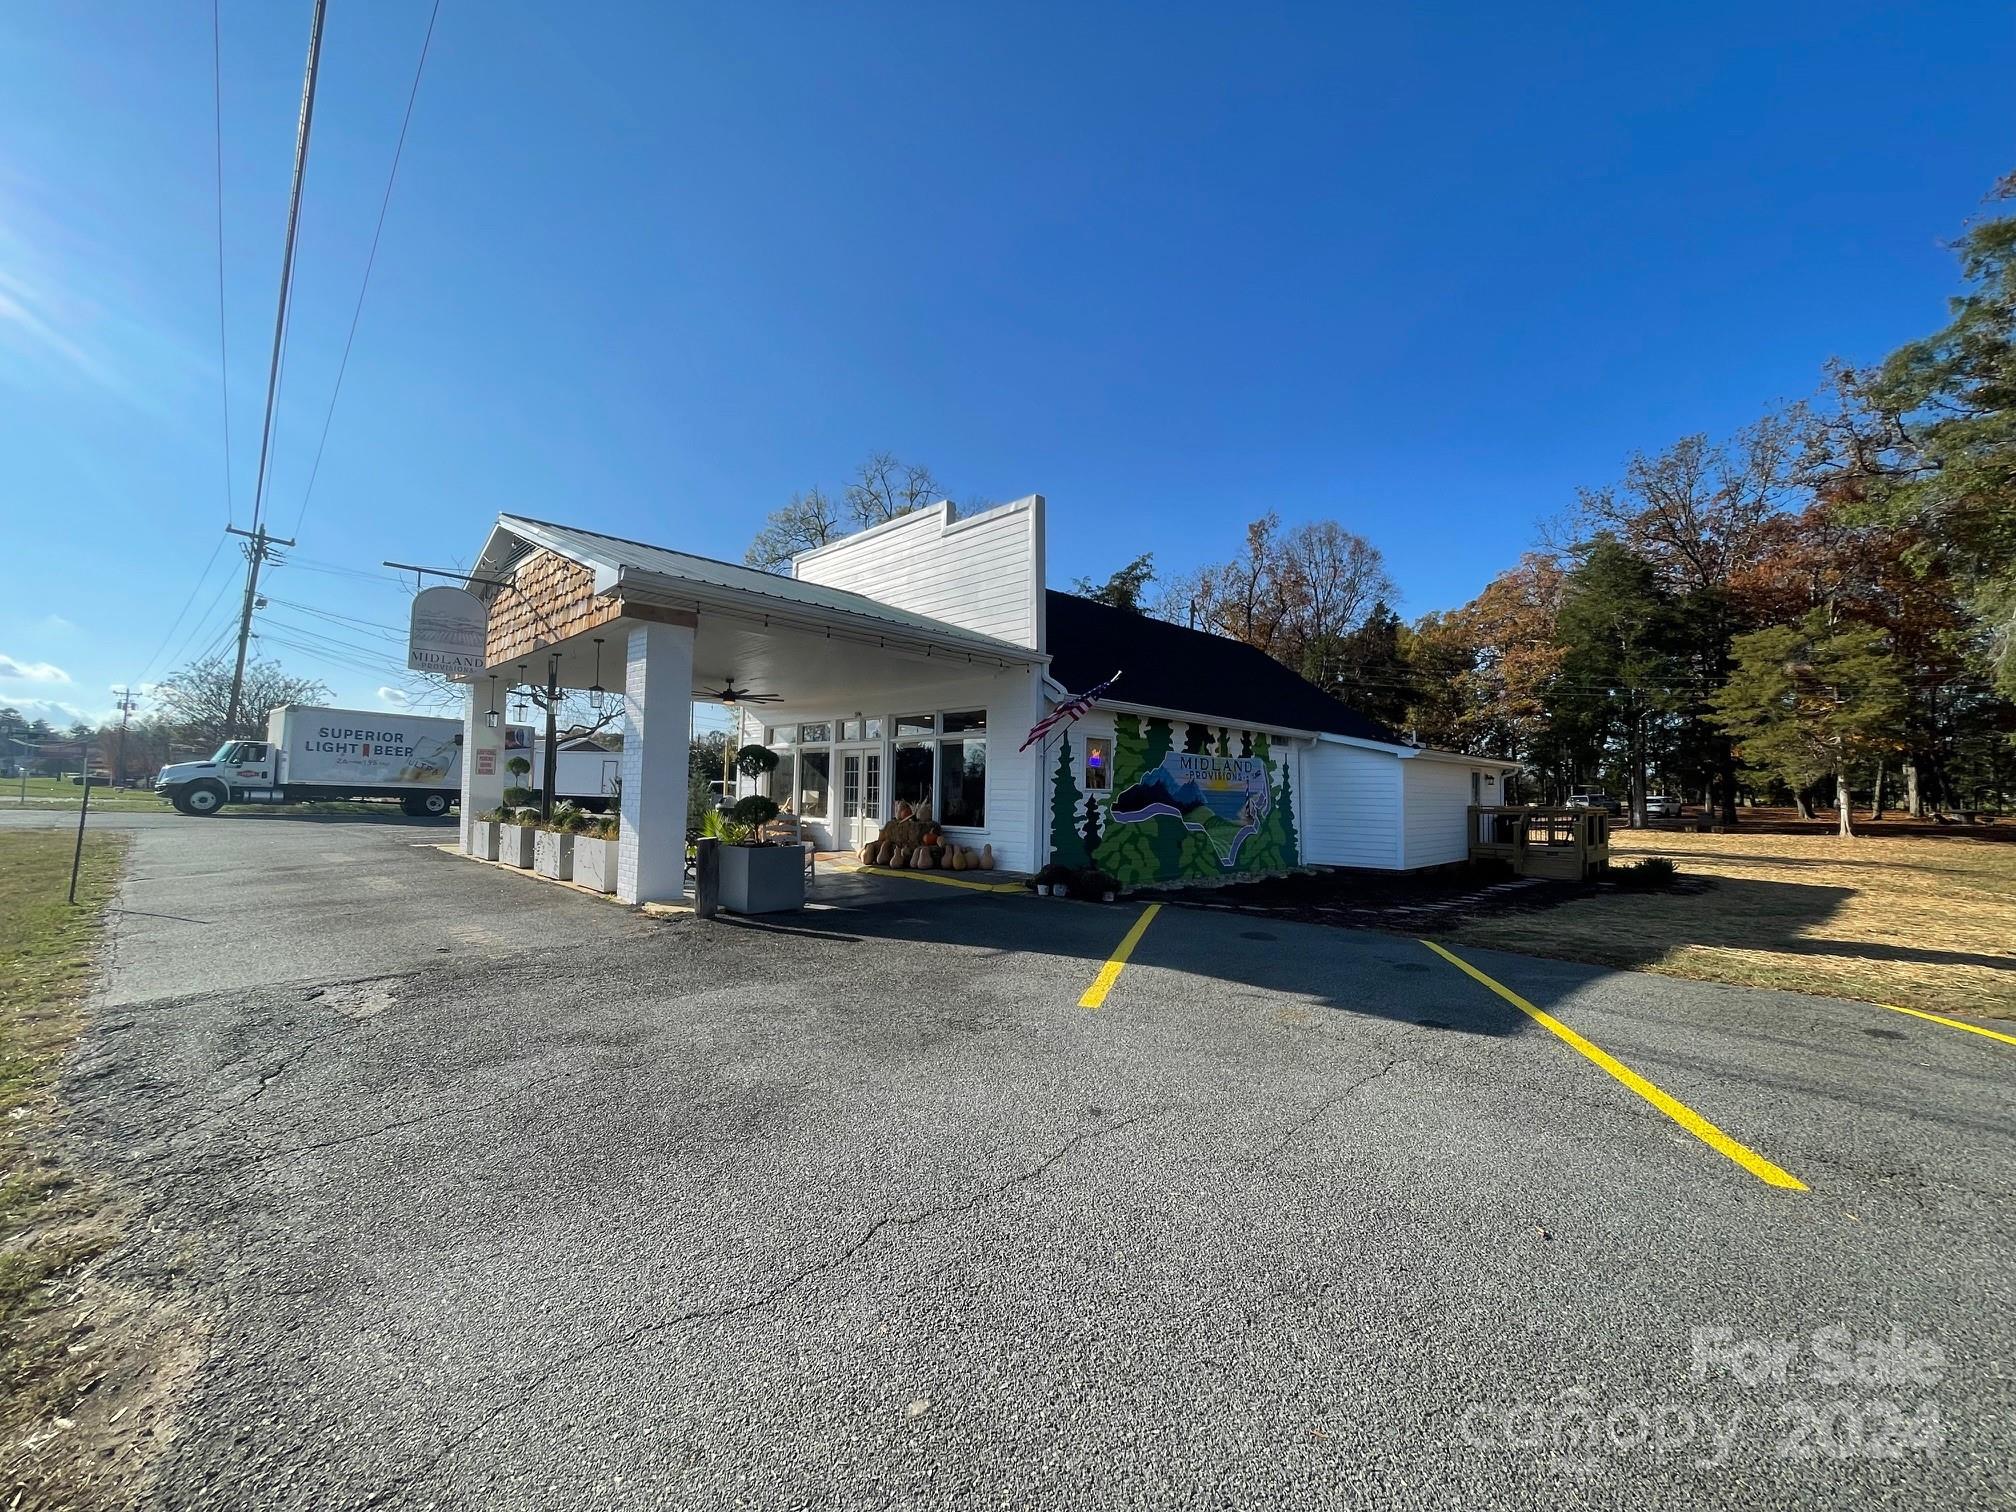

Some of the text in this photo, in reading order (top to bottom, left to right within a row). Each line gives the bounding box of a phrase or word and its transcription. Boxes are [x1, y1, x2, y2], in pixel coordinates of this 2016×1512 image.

[412, 651, 484, 668] MIDLAND
[319, 727, 404, 743] SUPERIOR
[305, 741, 358, 754] LIGHT
[408, 759, 439, 776] ULTRA
[1180, 757, 1252, 773] MIDLAND
